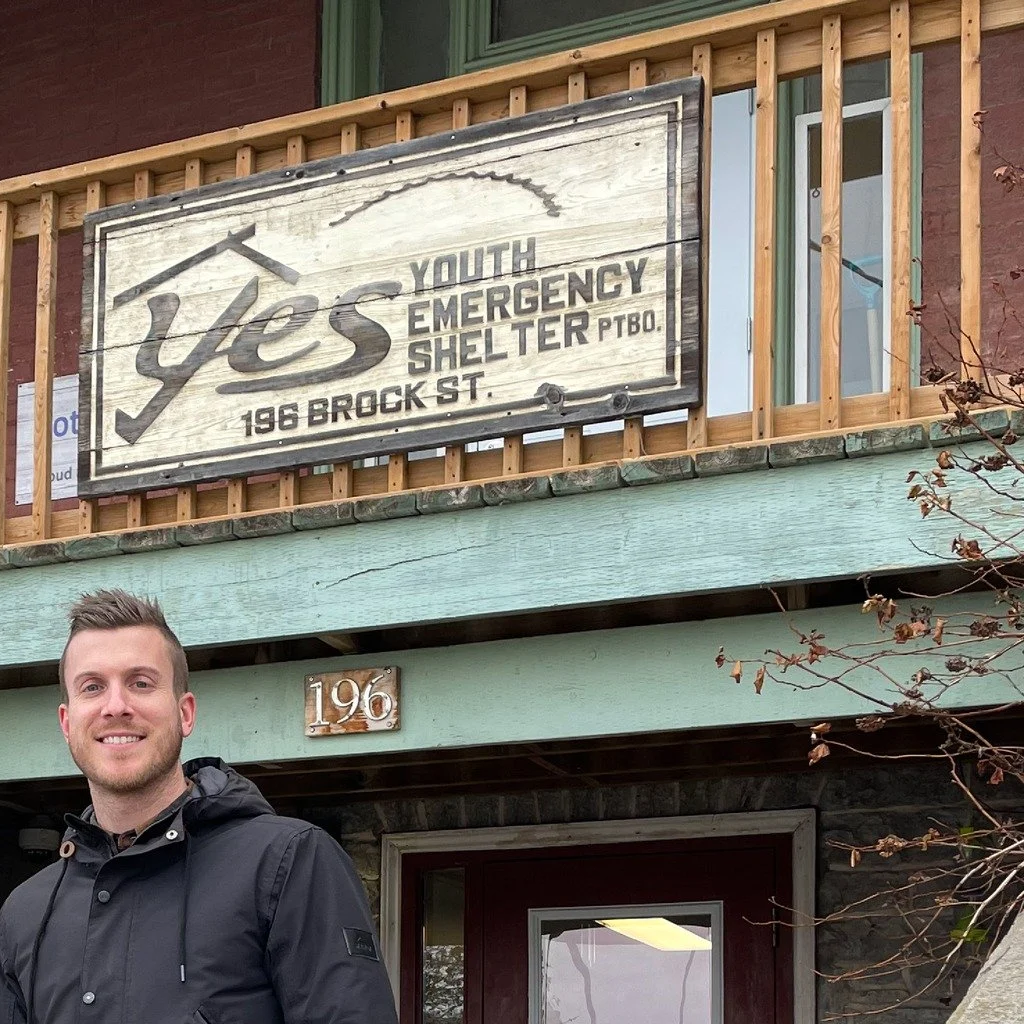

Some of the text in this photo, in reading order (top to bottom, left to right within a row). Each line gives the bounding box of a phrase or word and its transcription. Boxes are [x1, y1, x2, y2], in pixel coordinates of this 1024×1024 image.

[408, 257, 649, 336] EMERGENCY
[409, 237, 536, 295] YOUTH
[408, 309, 661, 375] SHELTER PTBO.
[240, 371, 493, 437] 196 BROCK ST.
[309, 674, 392, 726] 196
